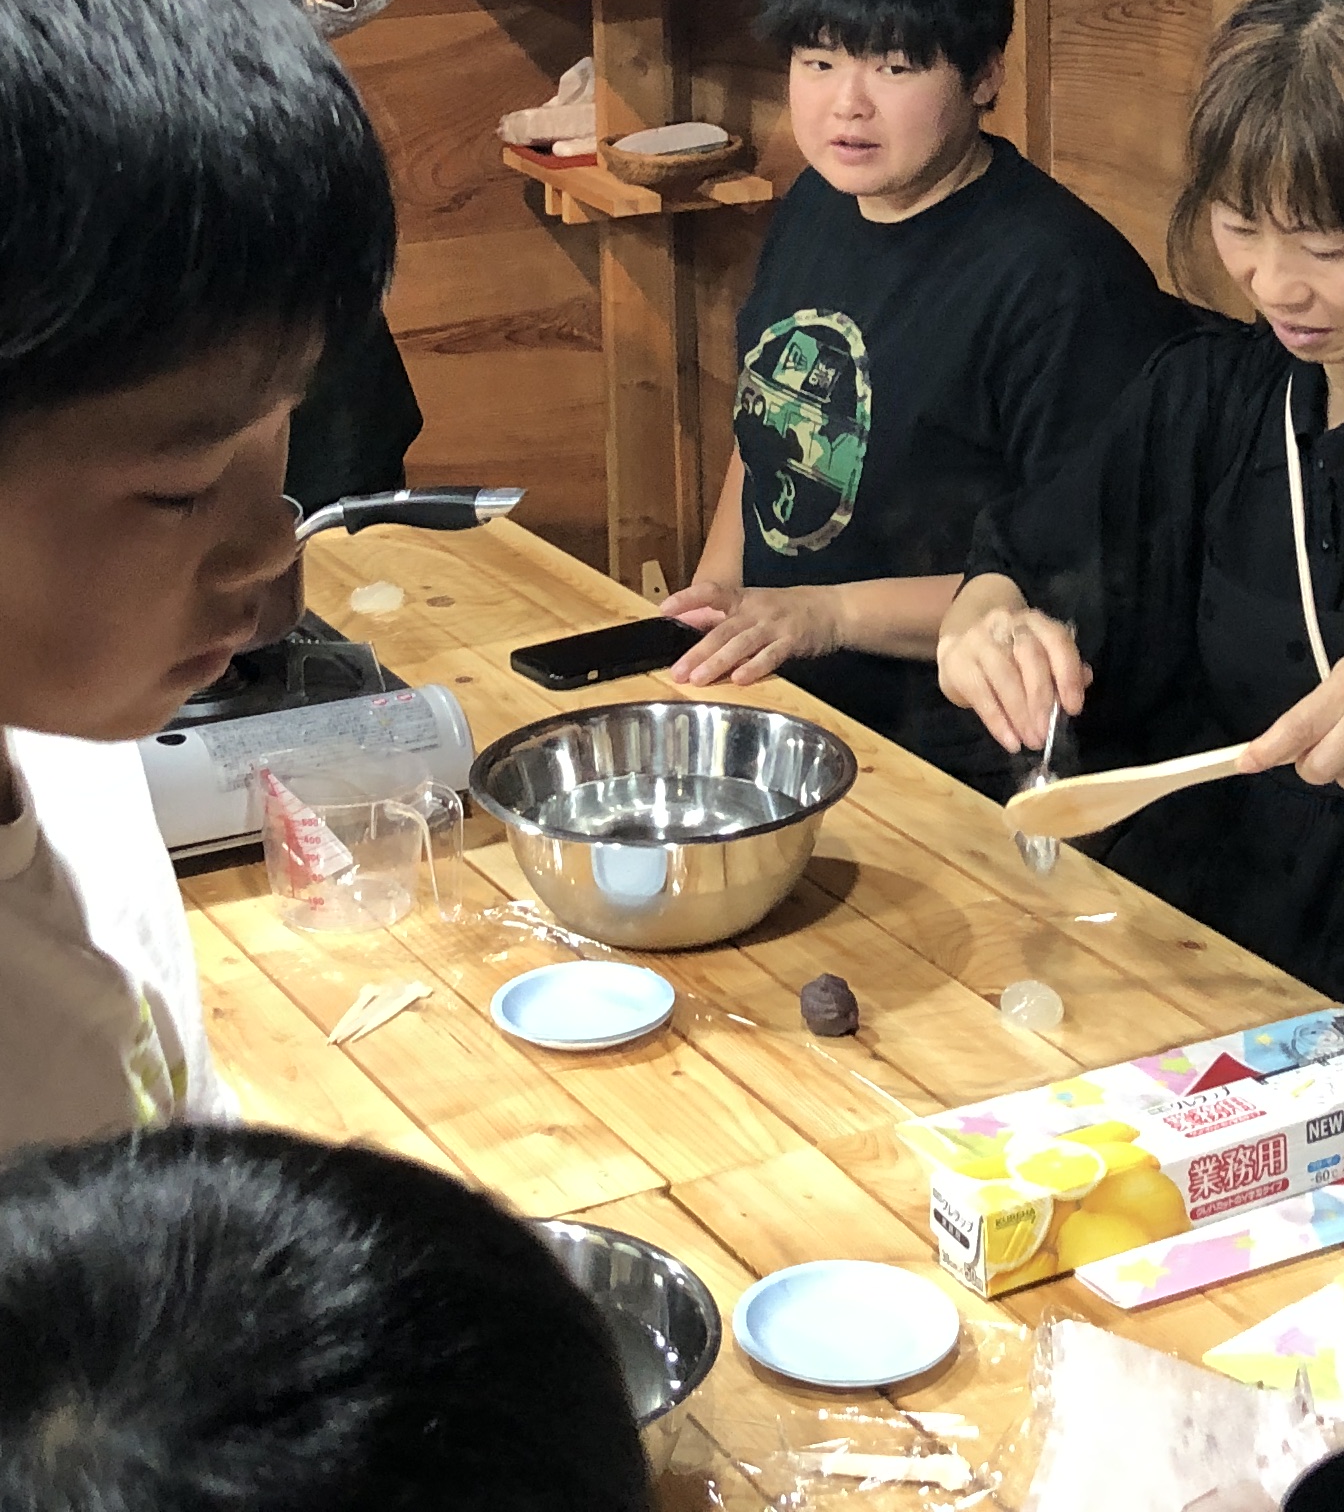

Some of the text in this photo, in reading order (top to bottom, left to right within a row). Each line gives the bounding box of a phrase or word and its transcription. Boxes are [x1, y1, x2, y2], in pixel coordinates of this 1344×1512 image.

[1307, 1111, 1344, 1142] NEW
[1188, 1133, 1287, 1203] 業務用
